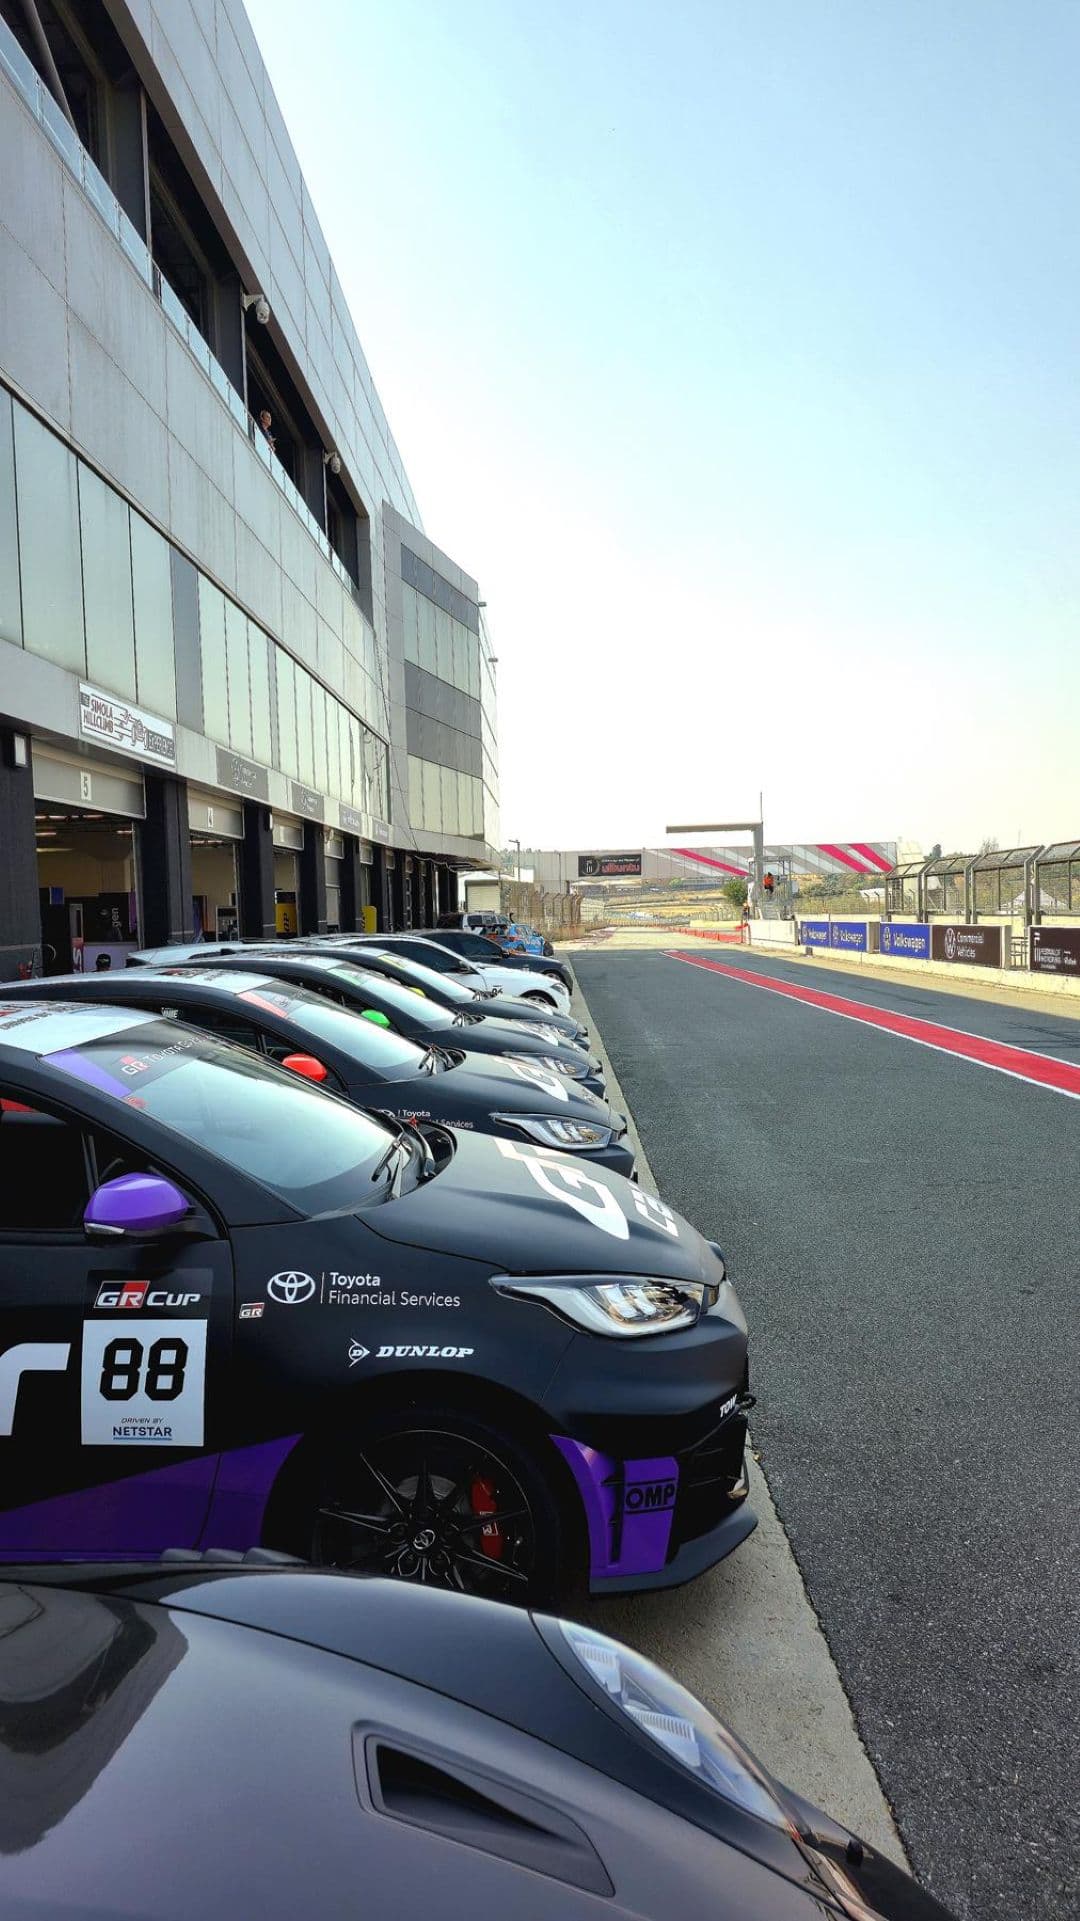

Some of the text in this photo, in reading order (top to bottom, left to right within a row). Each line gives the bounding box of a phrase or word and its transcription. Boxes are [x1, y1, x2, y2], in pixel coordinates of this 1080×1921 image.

[83, 776, 89, 797] 5
[893, 932, 926, 952] Volkswagen
[957, 931, 984, 944] Commercial
[402, 1109, 431, 1117] Toyota
[329, 1272, 381, 1289] Toyota
[96, 1291, 144, 1306] GR
[328, 1289, 461, 1307] Financial Services
[375, 1346, 474, 1358] DUNLOP
[100, 1337, 189, 1401] 88
[720, 1394, 737, 1418] TOW
[113, 1426, 172, 1437] NETSTAR
[626, 1483, 676, 1509] OMP
